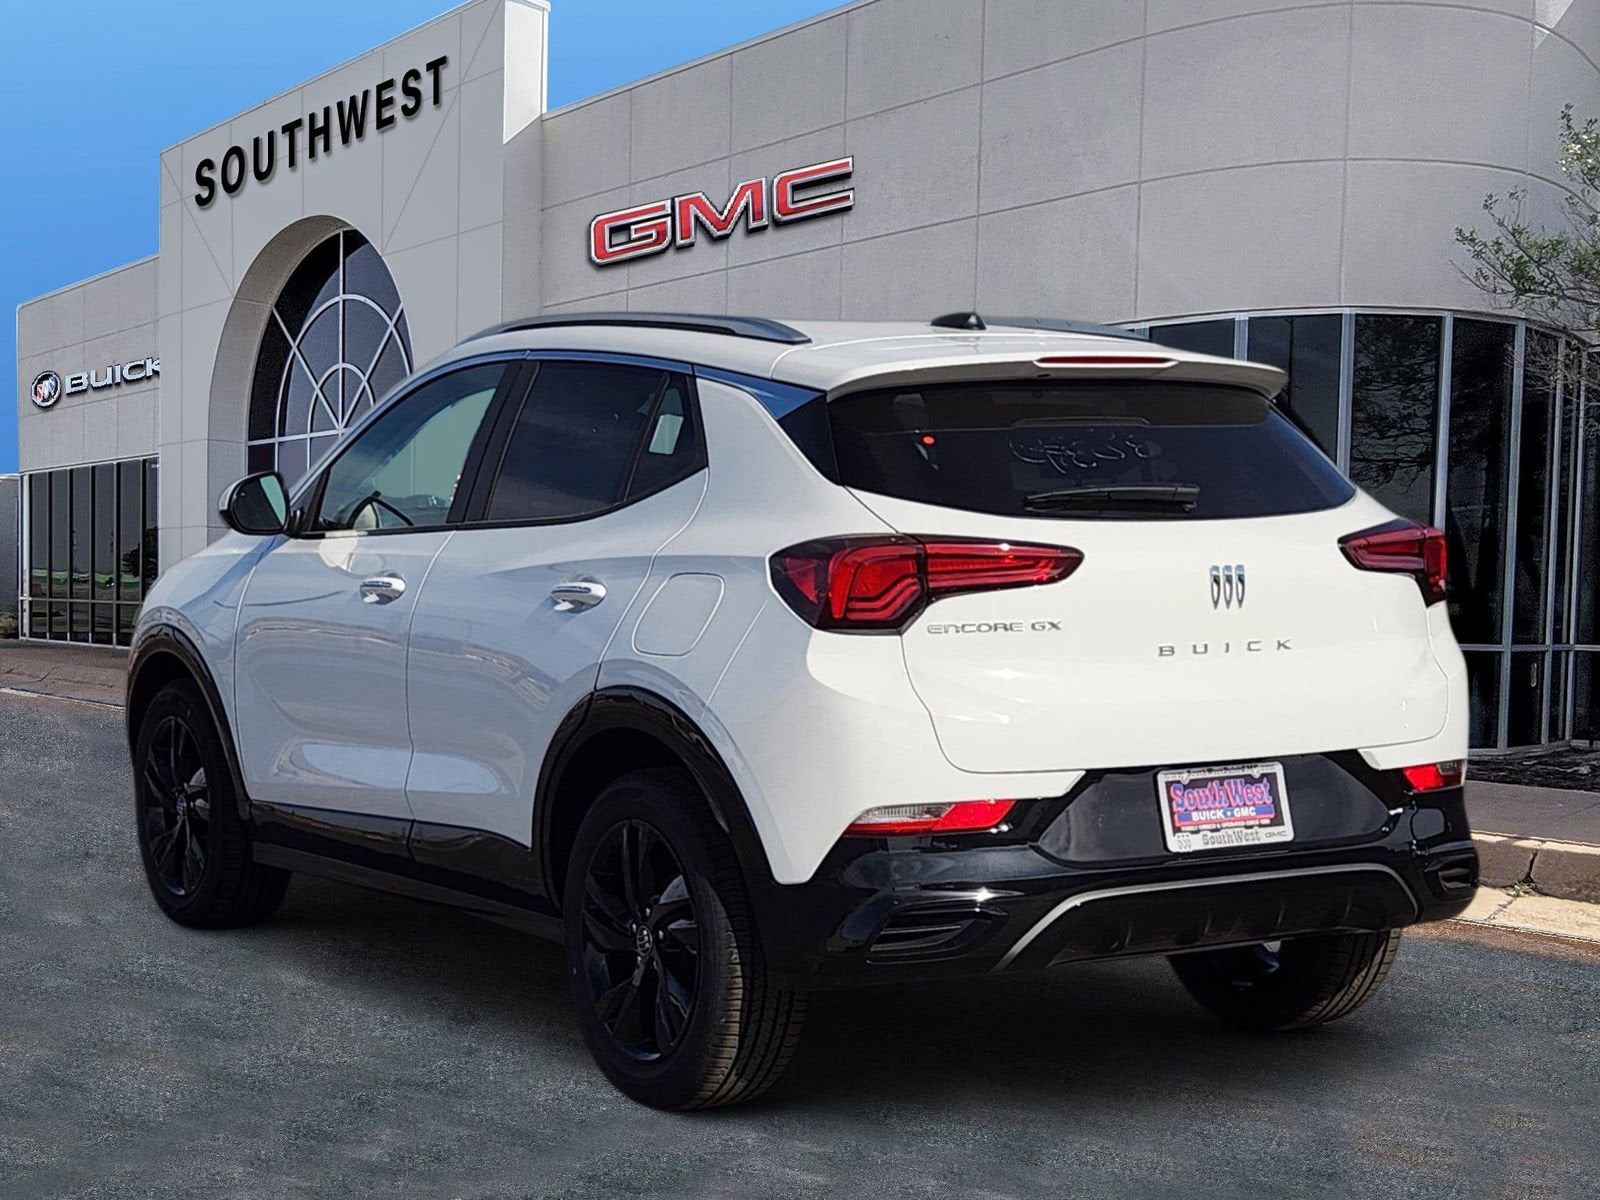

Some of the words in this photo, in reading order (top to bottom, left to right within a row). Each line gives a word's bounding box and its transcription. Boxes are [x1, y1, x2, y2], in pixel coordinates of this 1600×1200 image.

[194, 55, 448, 208] SOUTHWEST
[588, 155, 855, 266] GMC
[65, 357, 160, 396] BUICK
[1031, 620, 1062, 632] GX
[1157, 638, 1293, 657] BUICK
[1170, 777, 1273, 812] SouthWest
[1191, 807, 1225, 821] BUICK
[1233, 806, 1257, 818] GMC
[1202, 829, 1261, 846] SouthWest
[1264, 830, 1288, 839] GMC
